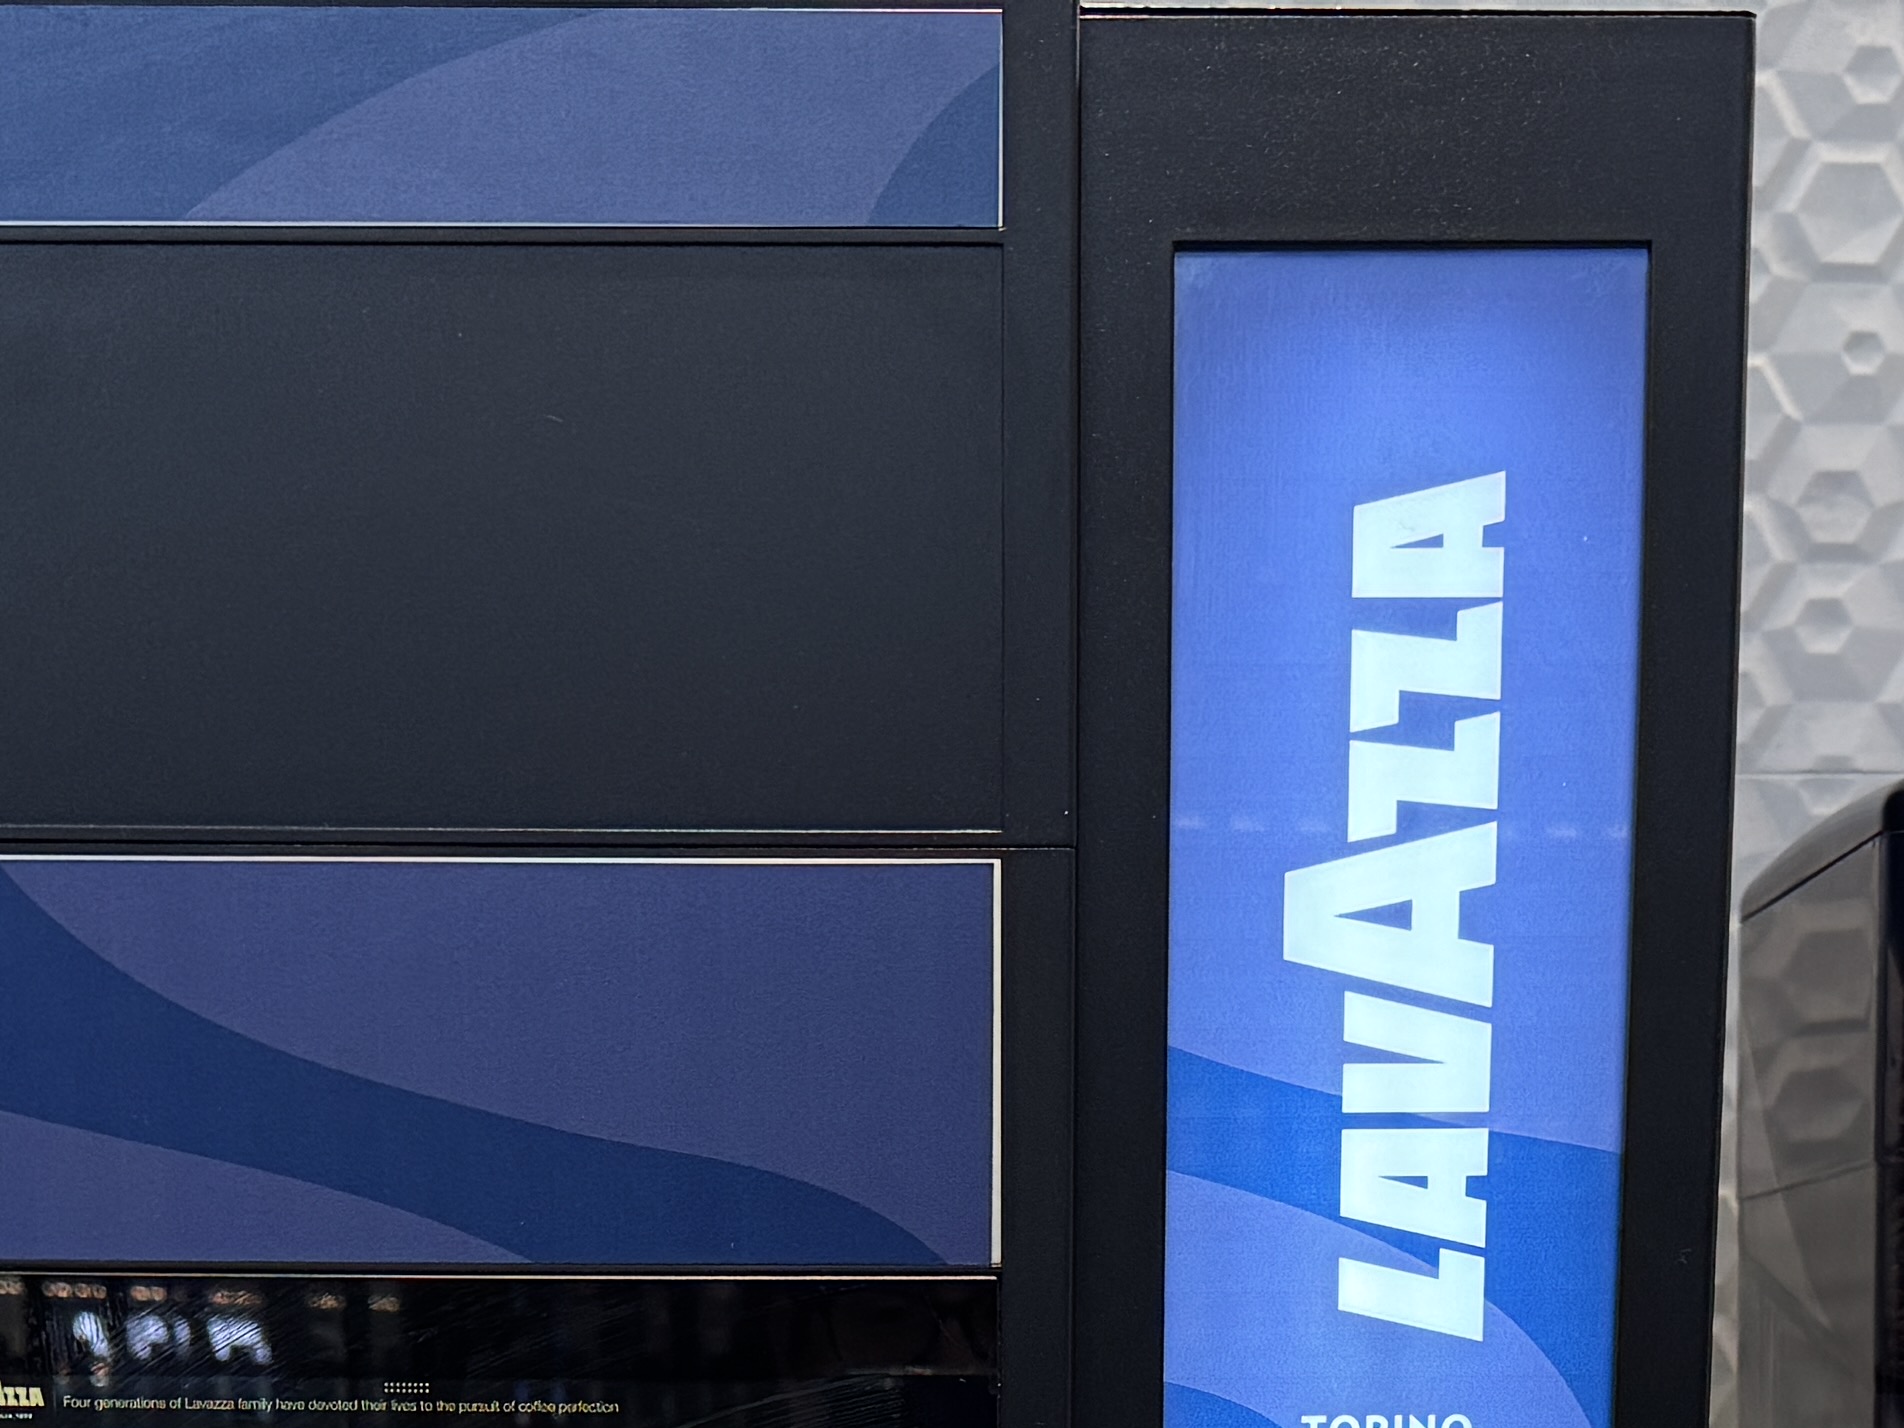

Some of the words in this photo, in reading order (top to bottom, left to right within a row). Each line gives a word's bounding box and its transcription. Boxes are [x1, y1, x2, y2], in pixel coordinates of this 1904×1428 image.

[1284, 470, 1507, 1342] LAVAZZA
[63, 1395, 91, 1409] Four
[169, 1396, 182, 1410] of
[185, 1397, 235, 1411] Lavazza
[238, 1397, 273, 1415] family
[420, 1400, 433, 1412] to
